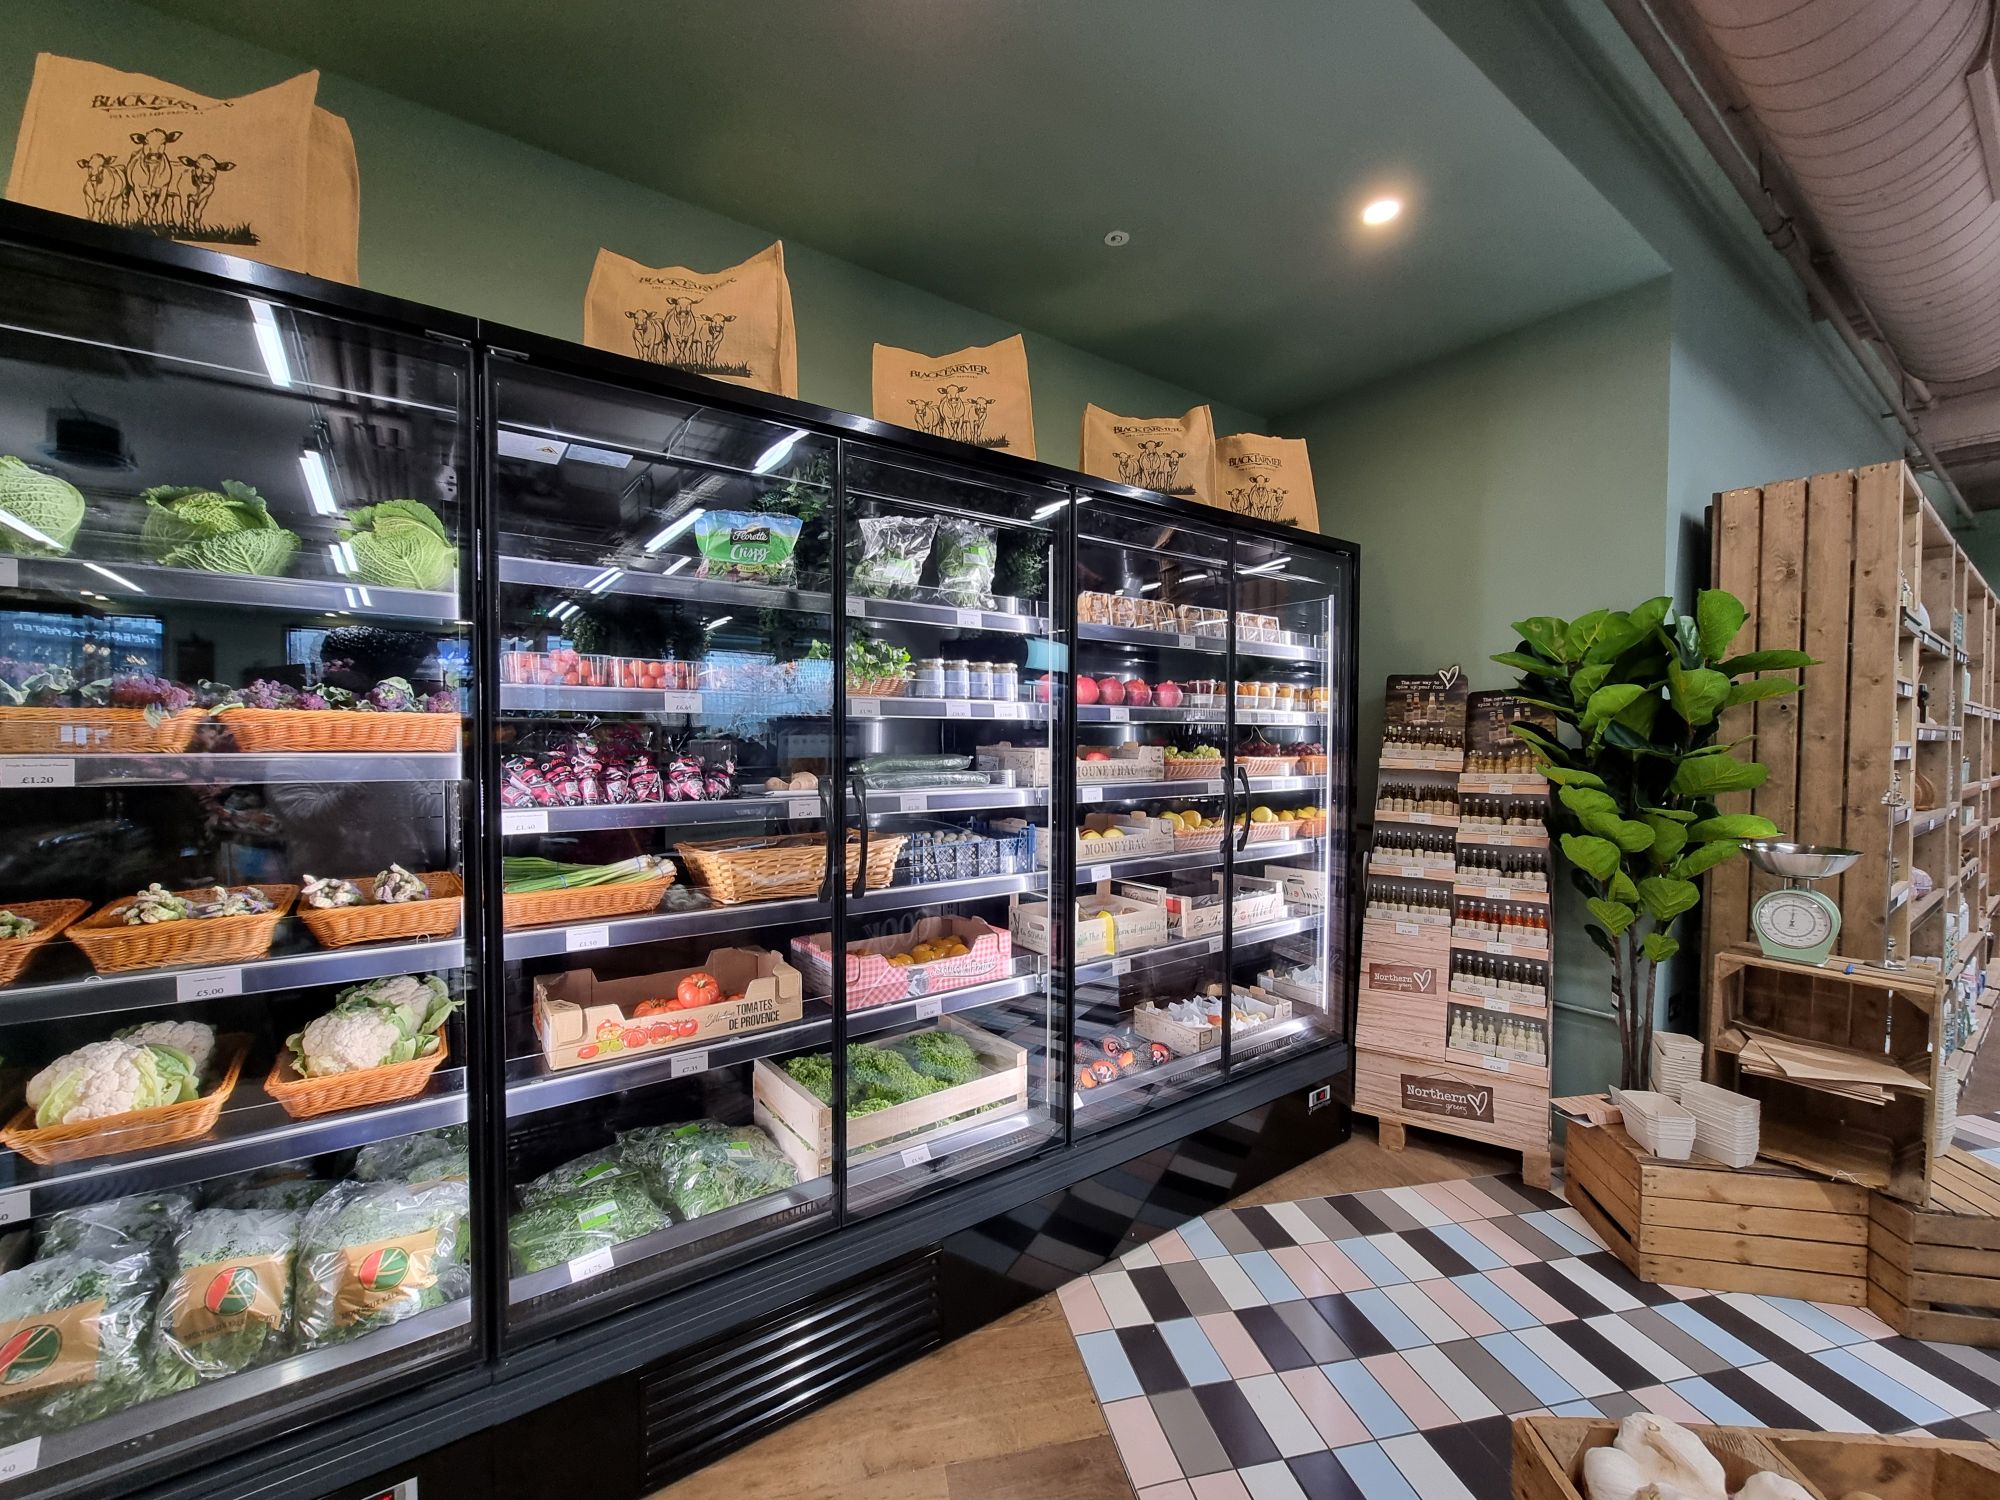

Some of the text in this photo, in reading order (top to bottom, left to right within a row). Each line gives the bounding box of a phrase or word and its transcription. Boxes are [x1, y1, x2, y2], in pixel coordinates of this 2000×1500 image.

[732, 529, 769, 541] Florette
[730, 543, 770, 562] Crispy
[20, 776, 55, 784] £1.20
[1374, 972, 1413, 983] Northern
[195, 987, 224, 997] £5.00
[736, 999, 773, 1015] TOMATES
[728, 1010, 780, 1031] DE PROVENCE
[1406, 1084, 1468, 1104] Northern
